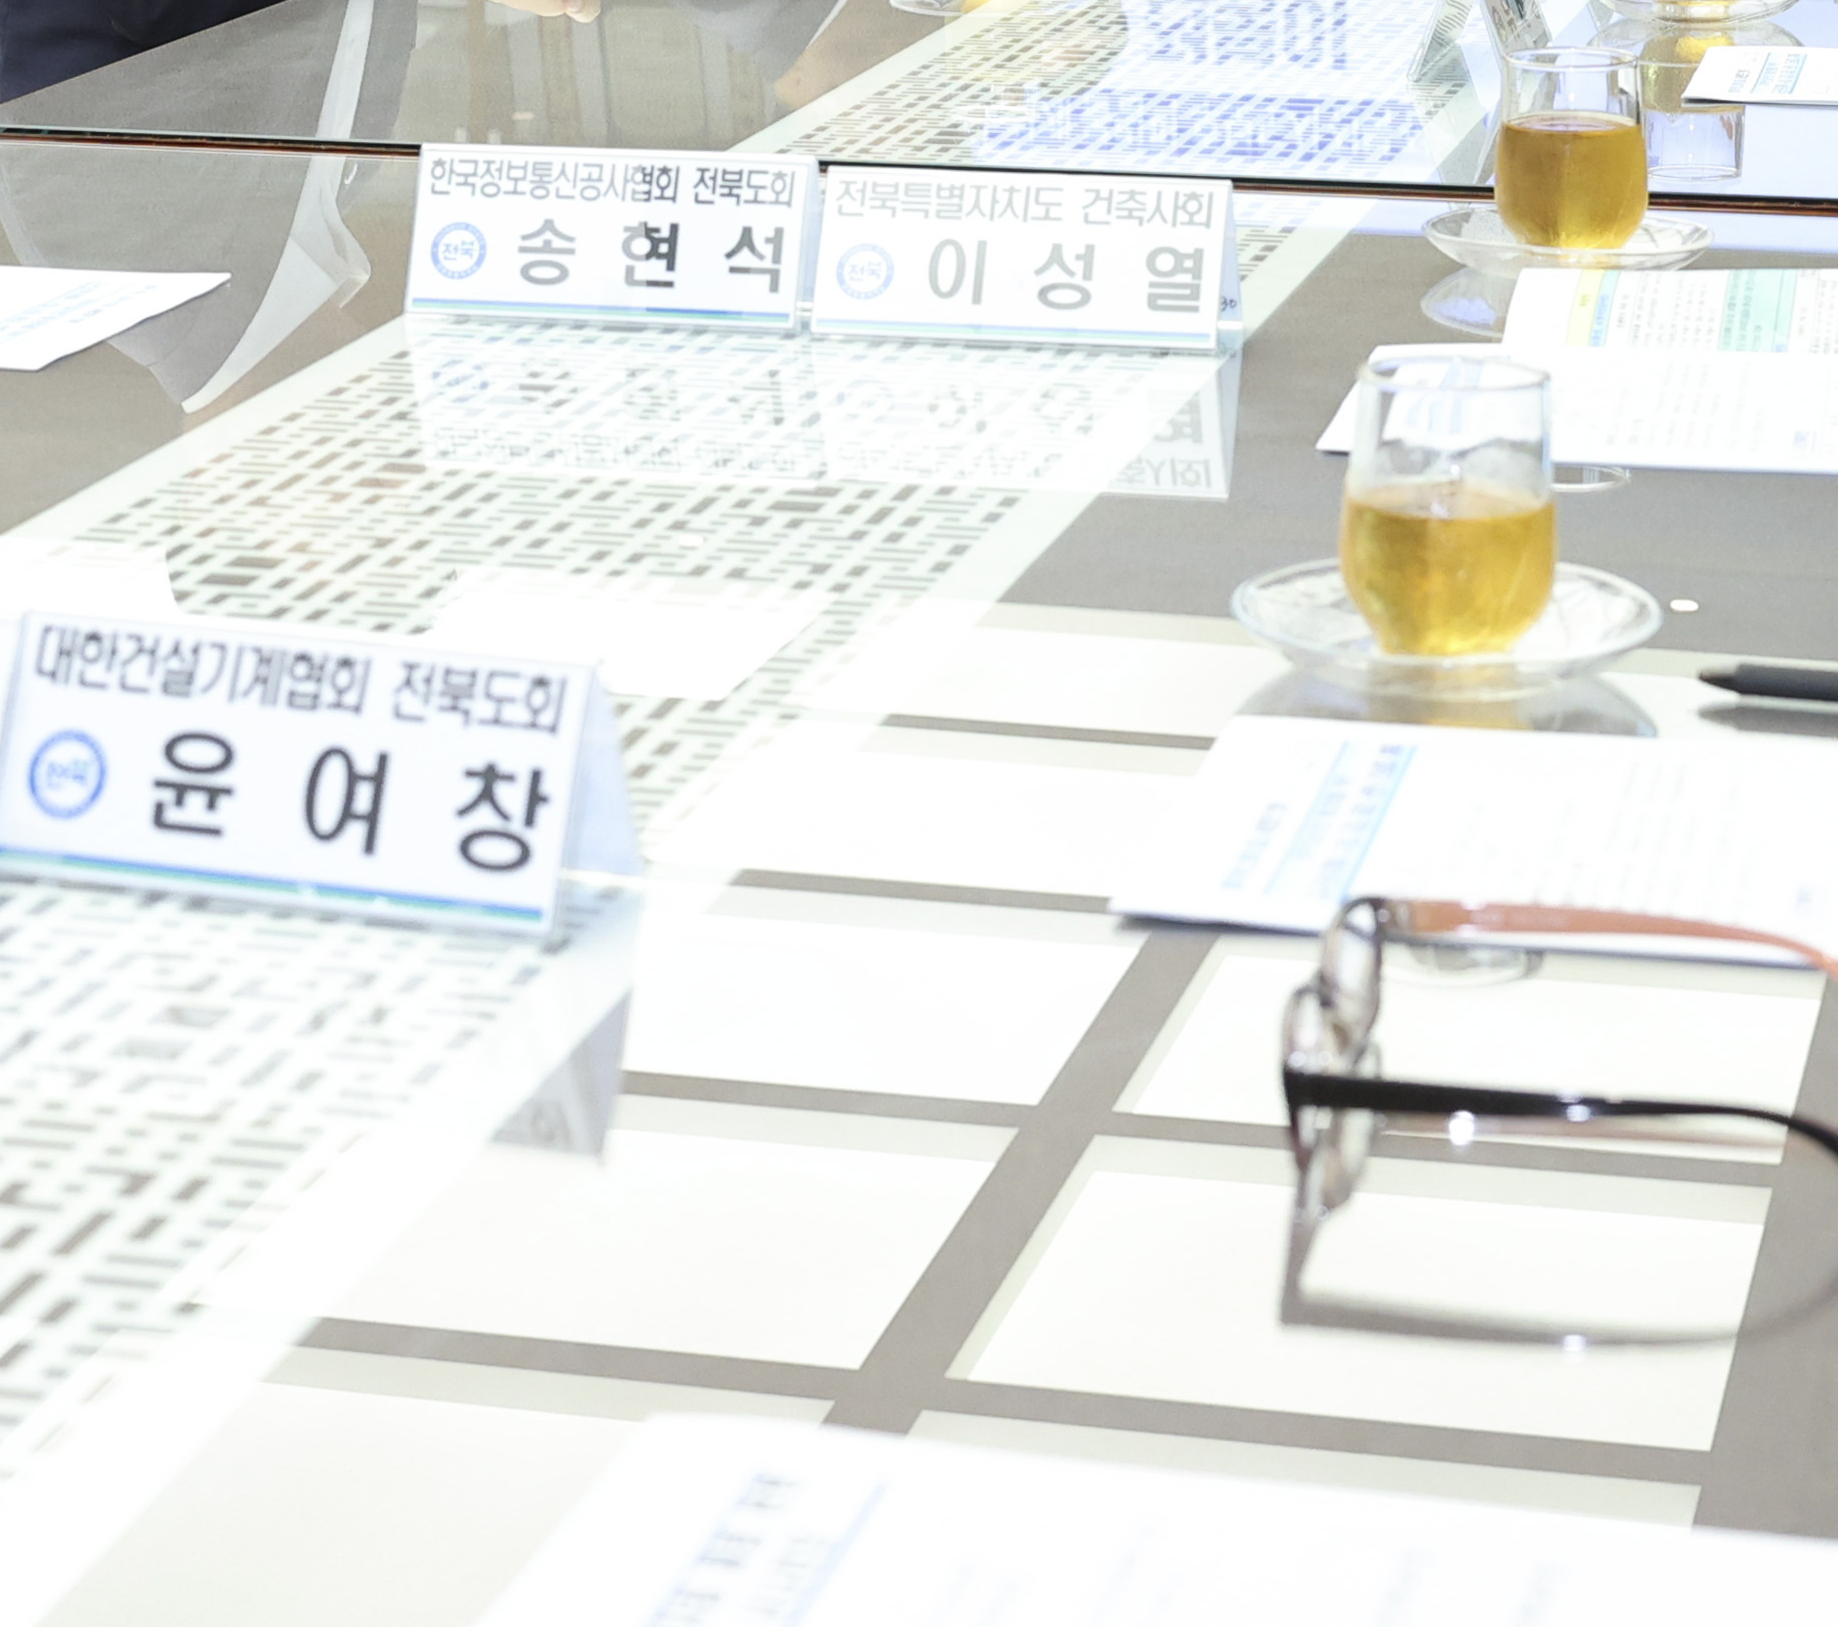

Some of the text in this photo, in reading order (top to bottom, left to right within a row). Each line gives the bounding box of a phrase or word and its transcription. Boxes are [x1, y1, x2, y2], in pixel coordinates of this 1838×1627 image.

[430, 157, 796, 209] 한국정보통신공사협회 전북도회
[835, 179, 1215, 230] 전북특별자치도 건축사회
[517, 218, 785, 294] 송현석
[926, 237, 1206, 314] 이성열
[35, 623, 568, 736] 대한건설기계협회 전북도회
[152, 731, 551, 873] 윤여창
